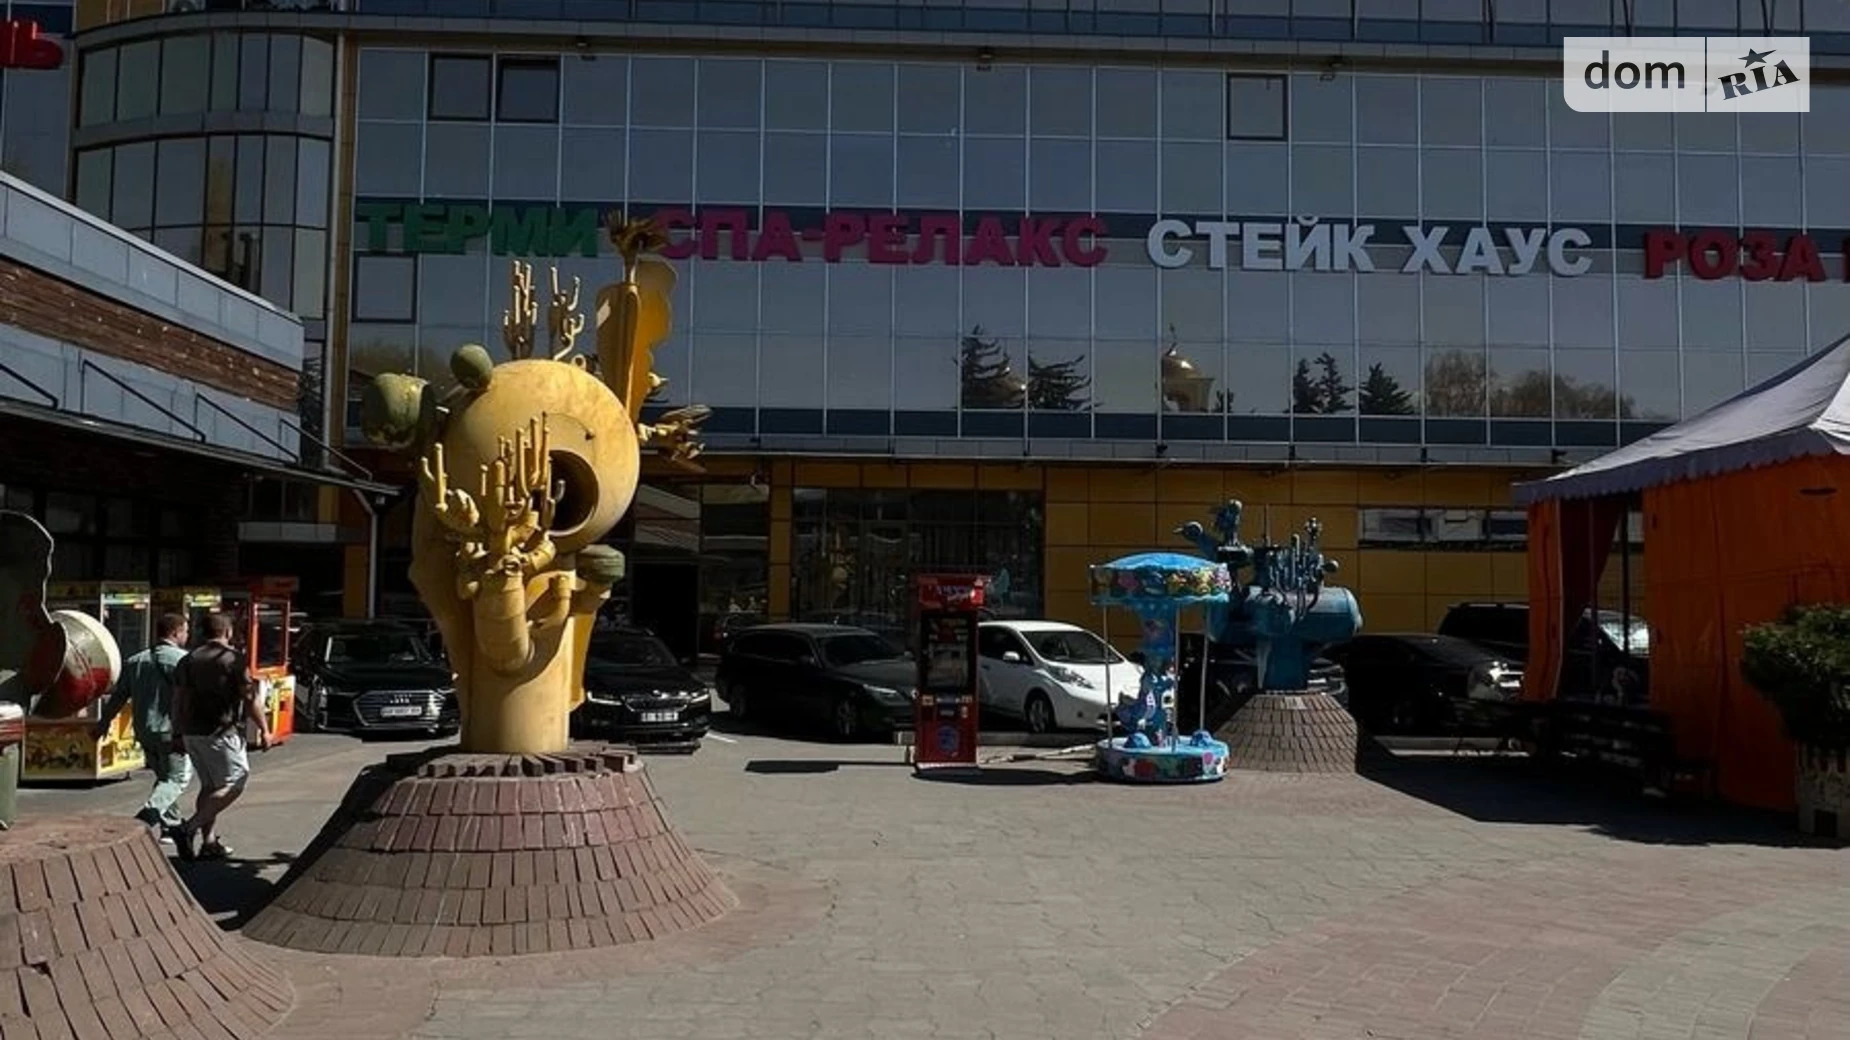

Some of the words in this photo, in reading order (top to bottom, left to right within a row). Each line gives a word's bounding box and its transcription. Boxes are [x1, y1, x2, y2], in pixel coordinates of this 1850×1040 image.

[355, 202, 599, 257] ТЕРМИ
[652, 206, 1109, 267] СПА-РЕЛАКС
[1146, 215, 1376, 273] СТЕЙК
[1401, 224, 1594, 277] ХАУС
[1643, 226, 1826, 282] РОЗА
